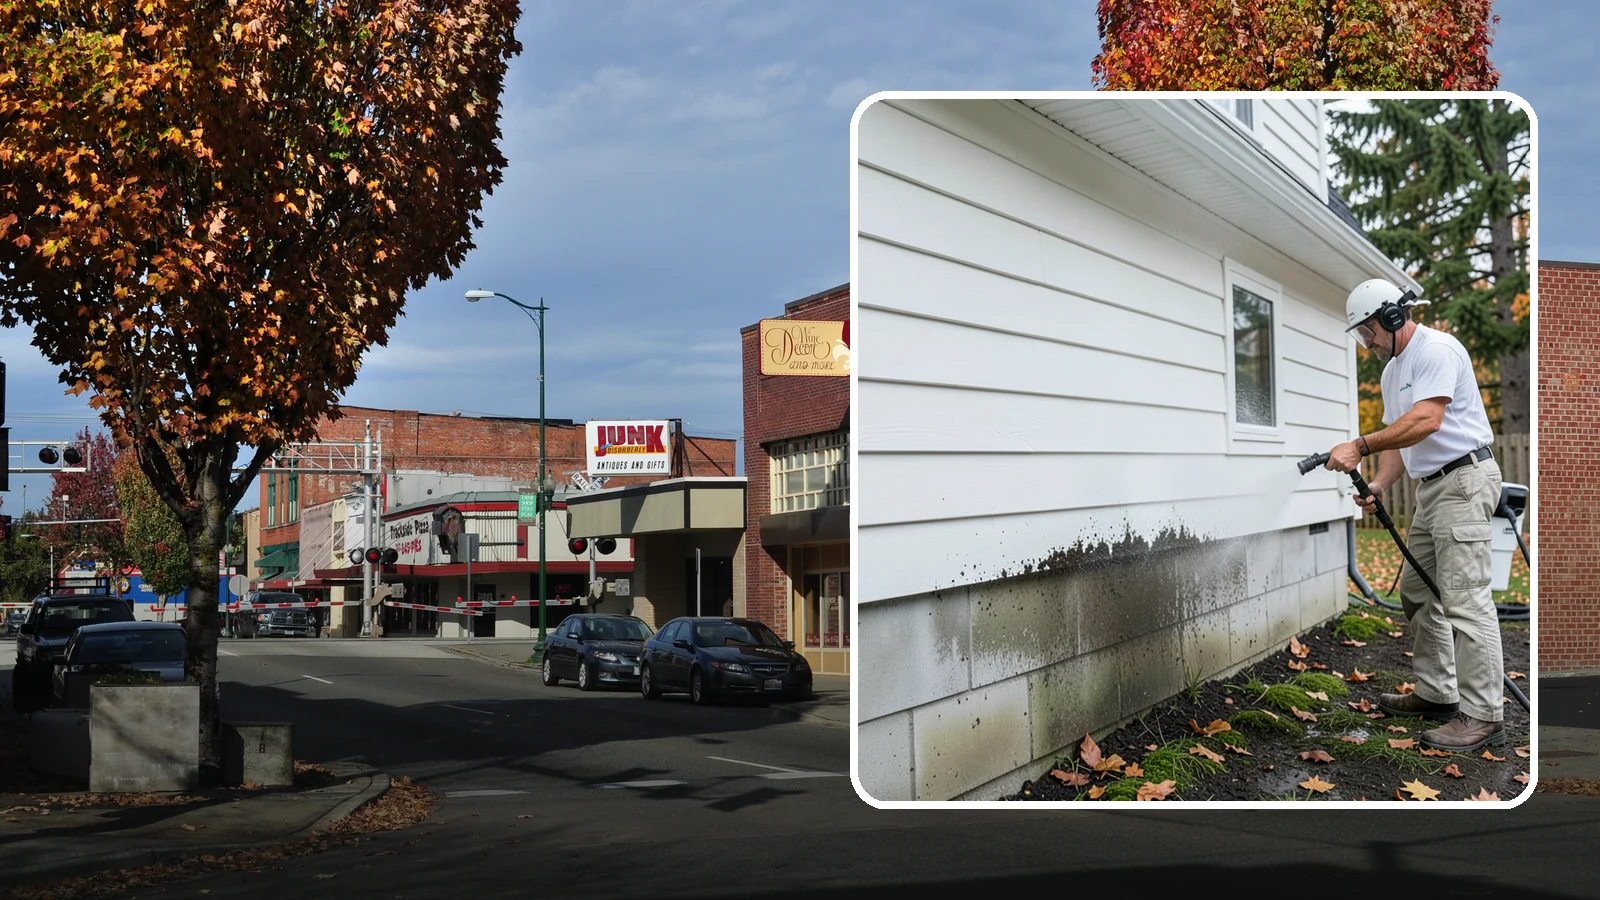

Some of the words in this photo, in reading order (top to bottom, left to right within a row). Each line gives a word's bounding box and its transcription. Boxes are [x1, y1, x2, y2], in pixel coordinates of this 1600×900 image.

[595, 425, 665, 457] JUNK
[607, 446, 646, 454] DISORDERLY
[597, 461, 628, 470] ANTIQUES
[631, 461, 643, 470] AND
[647, 460, 665, 469] GIFTS
[414, 519, 429, 535] Pizza
